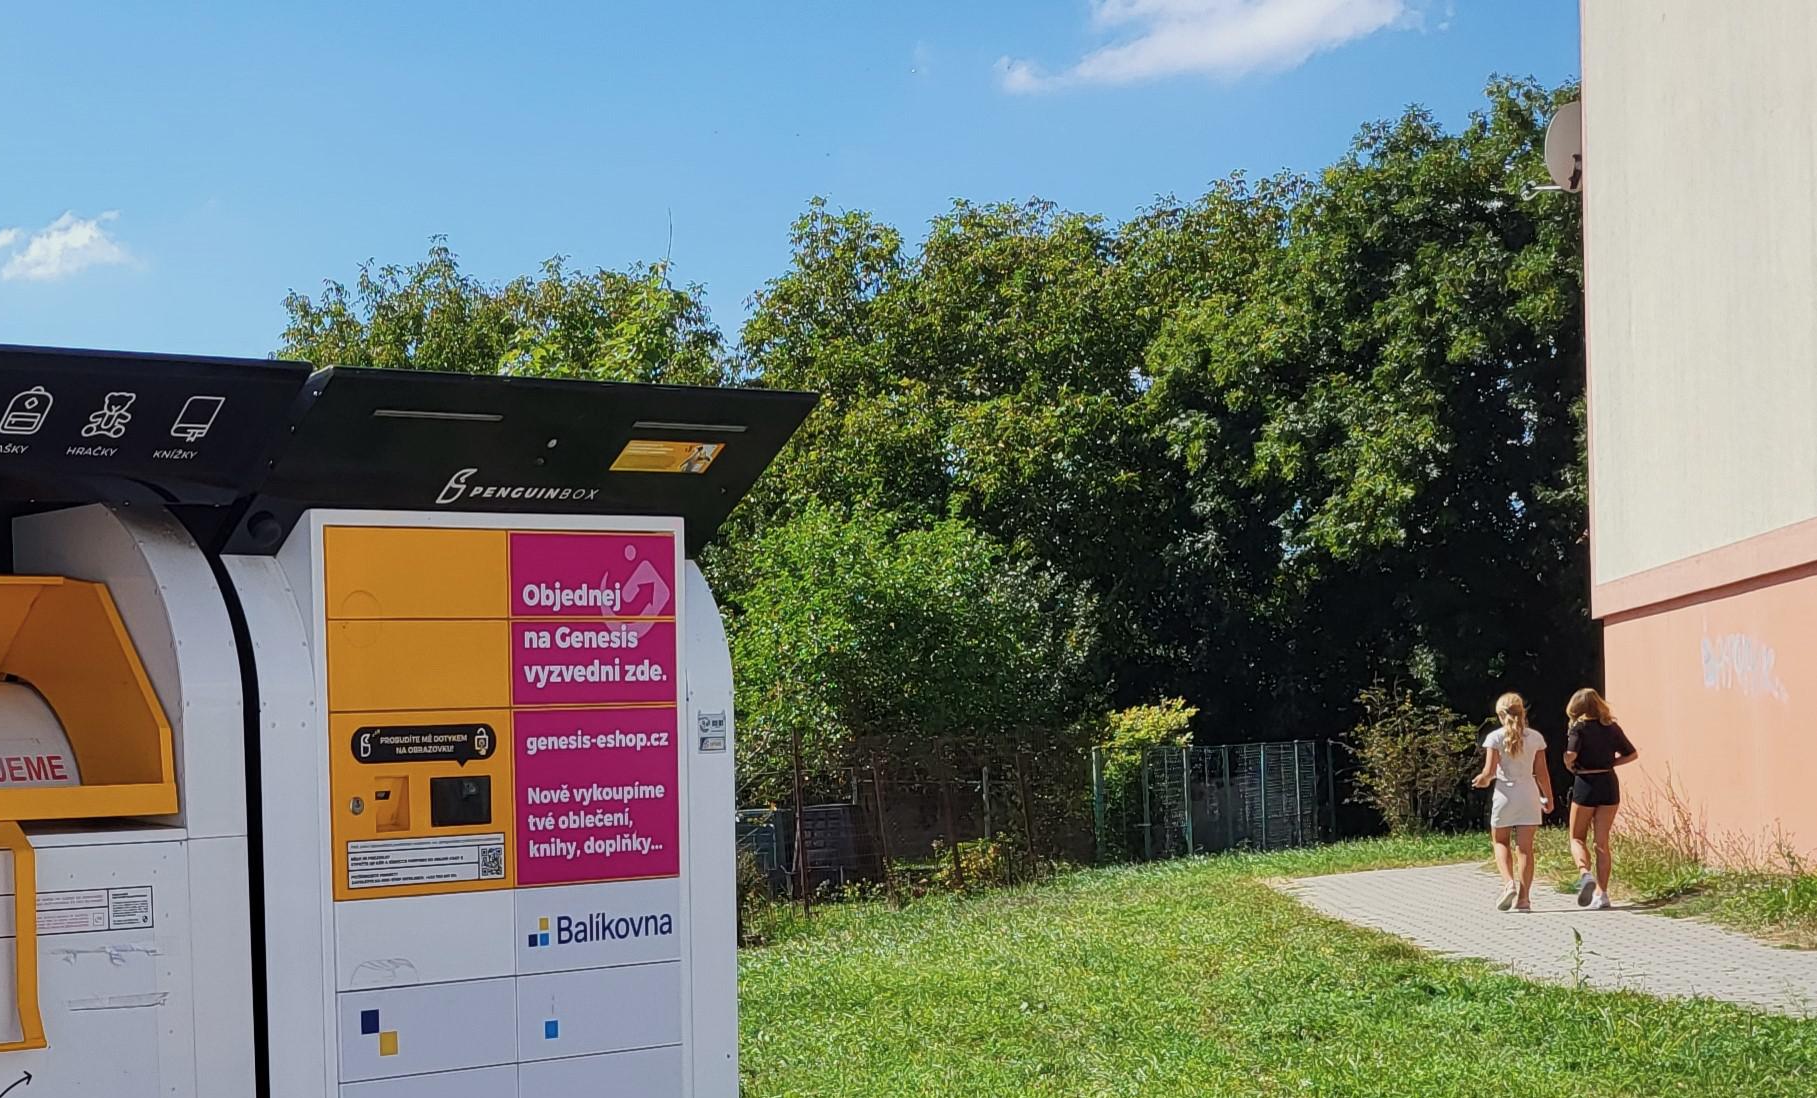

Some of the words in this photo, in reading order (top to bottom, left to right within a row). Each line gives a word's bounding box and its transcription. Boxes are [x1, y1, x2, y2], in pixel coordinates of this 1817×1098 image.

[66, 445, 119, 458] HRAČKY
[153, 447, 199, 460] KNÍŽKY
[469, 485, 600, 501] PENGUINBOX
[523, 584, 621, 611] Objednej
[524, 630, 551, 649] na
[555, 626, 639, 649] Genesis
[524, 658, 621, 688] vyzvedni
[624, 659, 667, 682] zde.
[396, 746, 406, 754] NA
[526, 730, 669, 756] genesis-eshop.cz
[527, 784, 568, 805] Nově
[572, 780, 665, 804] vykoupíme
[528, 812, 554, 830] tvé
[558, 808, 633, 831] oblečení,
[529, 838, 582, 860] knihy,
[556, 911, 673, 945] Balíkovna
